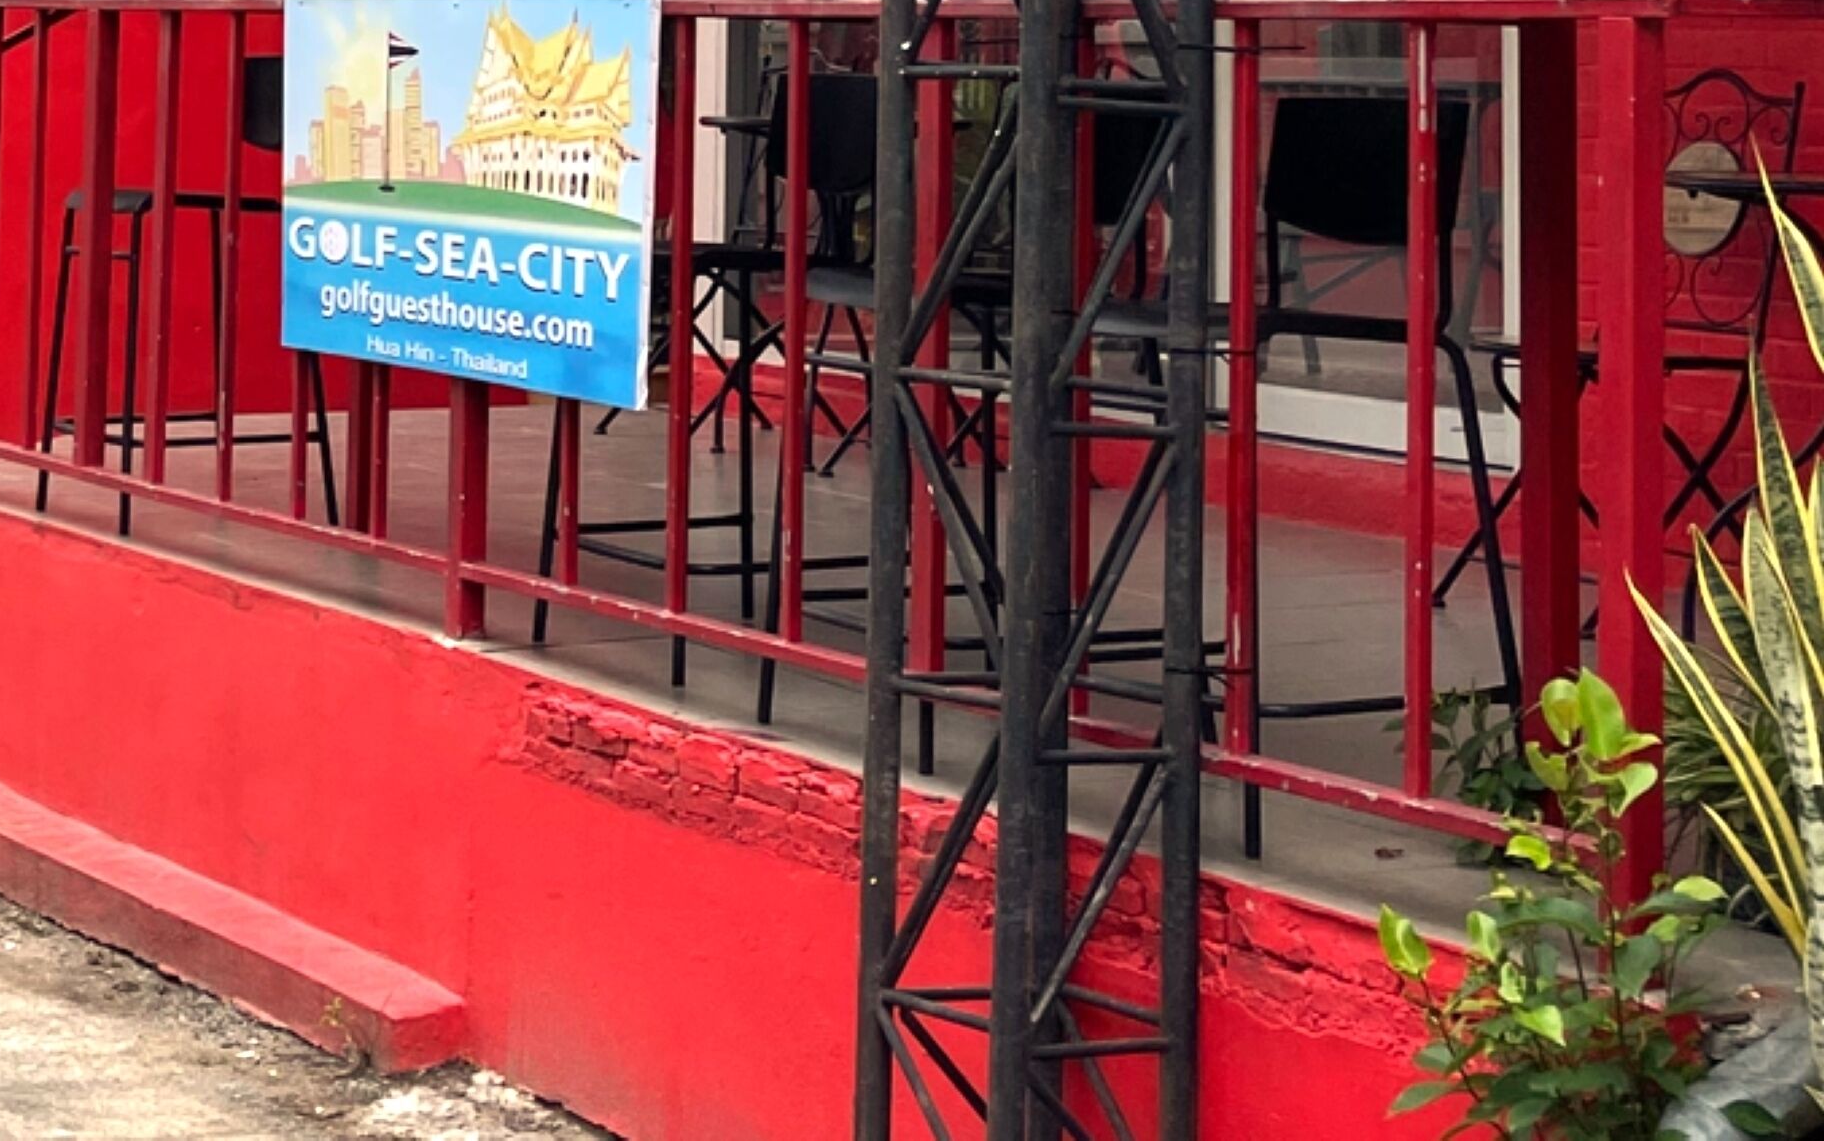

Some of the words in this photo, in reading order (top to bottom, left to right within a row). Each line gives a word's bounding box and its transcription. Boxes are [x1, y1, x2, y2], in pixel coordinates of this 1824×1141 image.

[288, 216, 631, 303] GOLF-SEA-CITY
[320, 279, 594, 349] golfguesthouse.com
[366, 334, 400, 358] Hua
[404, 340, 436, 364] Hin
[451, 345, 528, 380] Thailand
